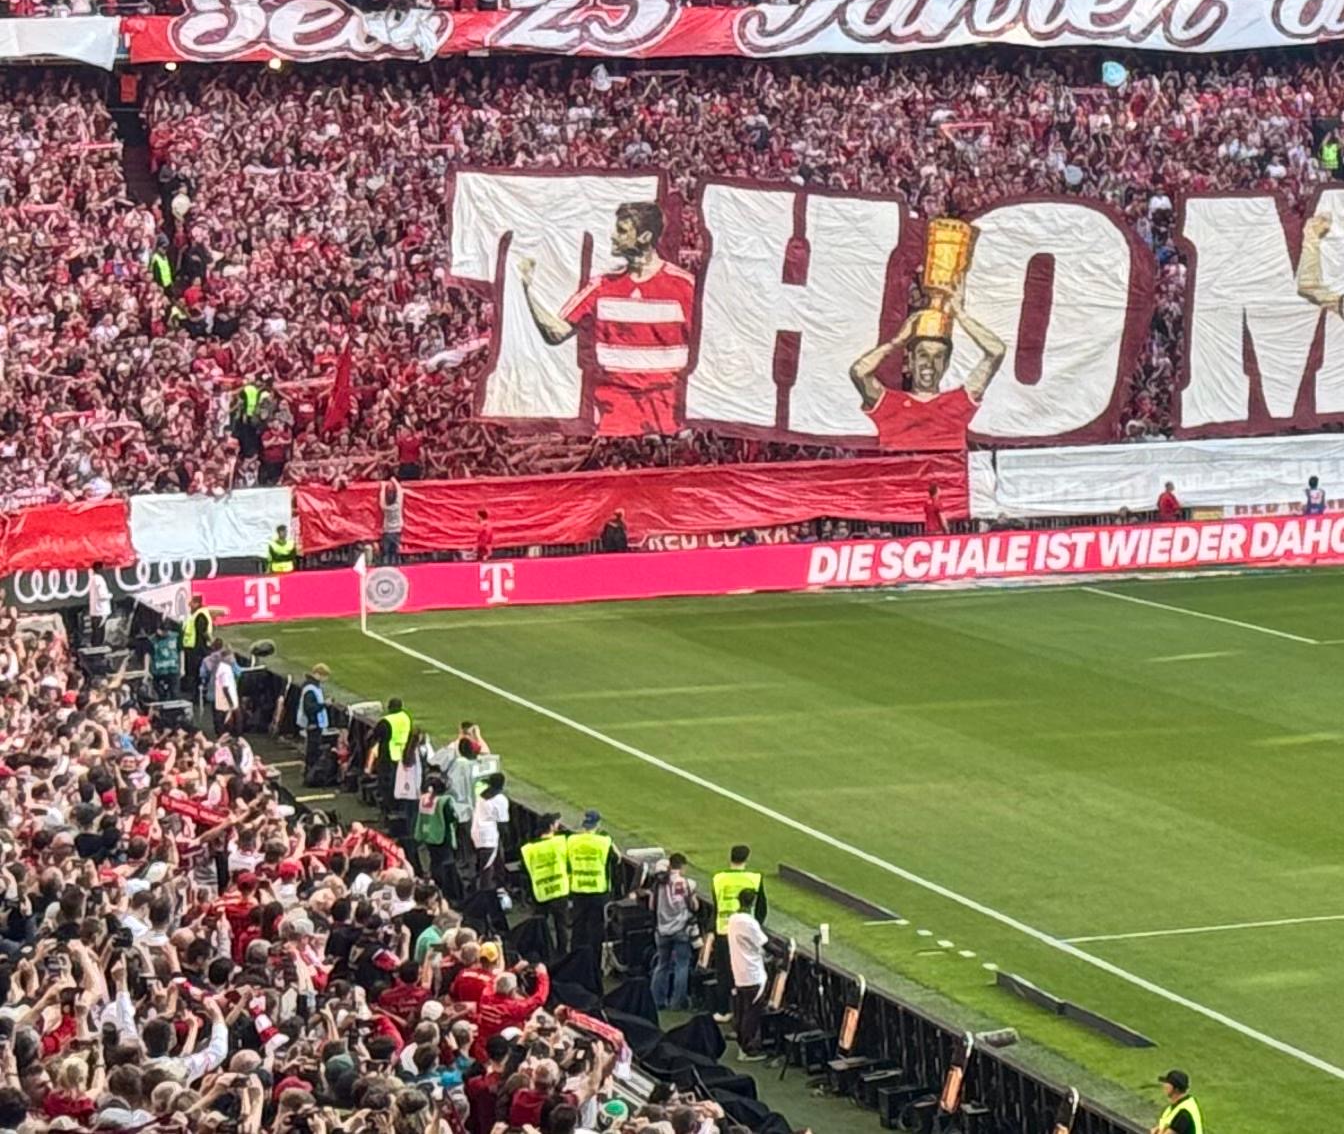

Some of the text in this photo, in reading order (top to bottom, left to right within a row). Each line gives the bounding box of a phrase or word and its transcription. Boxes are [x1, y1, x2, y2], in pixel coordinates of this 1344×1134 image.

[806, 544, 872, 585] DIE
[878, 536, 1030, 580] SCHALE
[1033, 530, 1096, 571] IST
[1099, 522, 1247, 565] WIEDER
